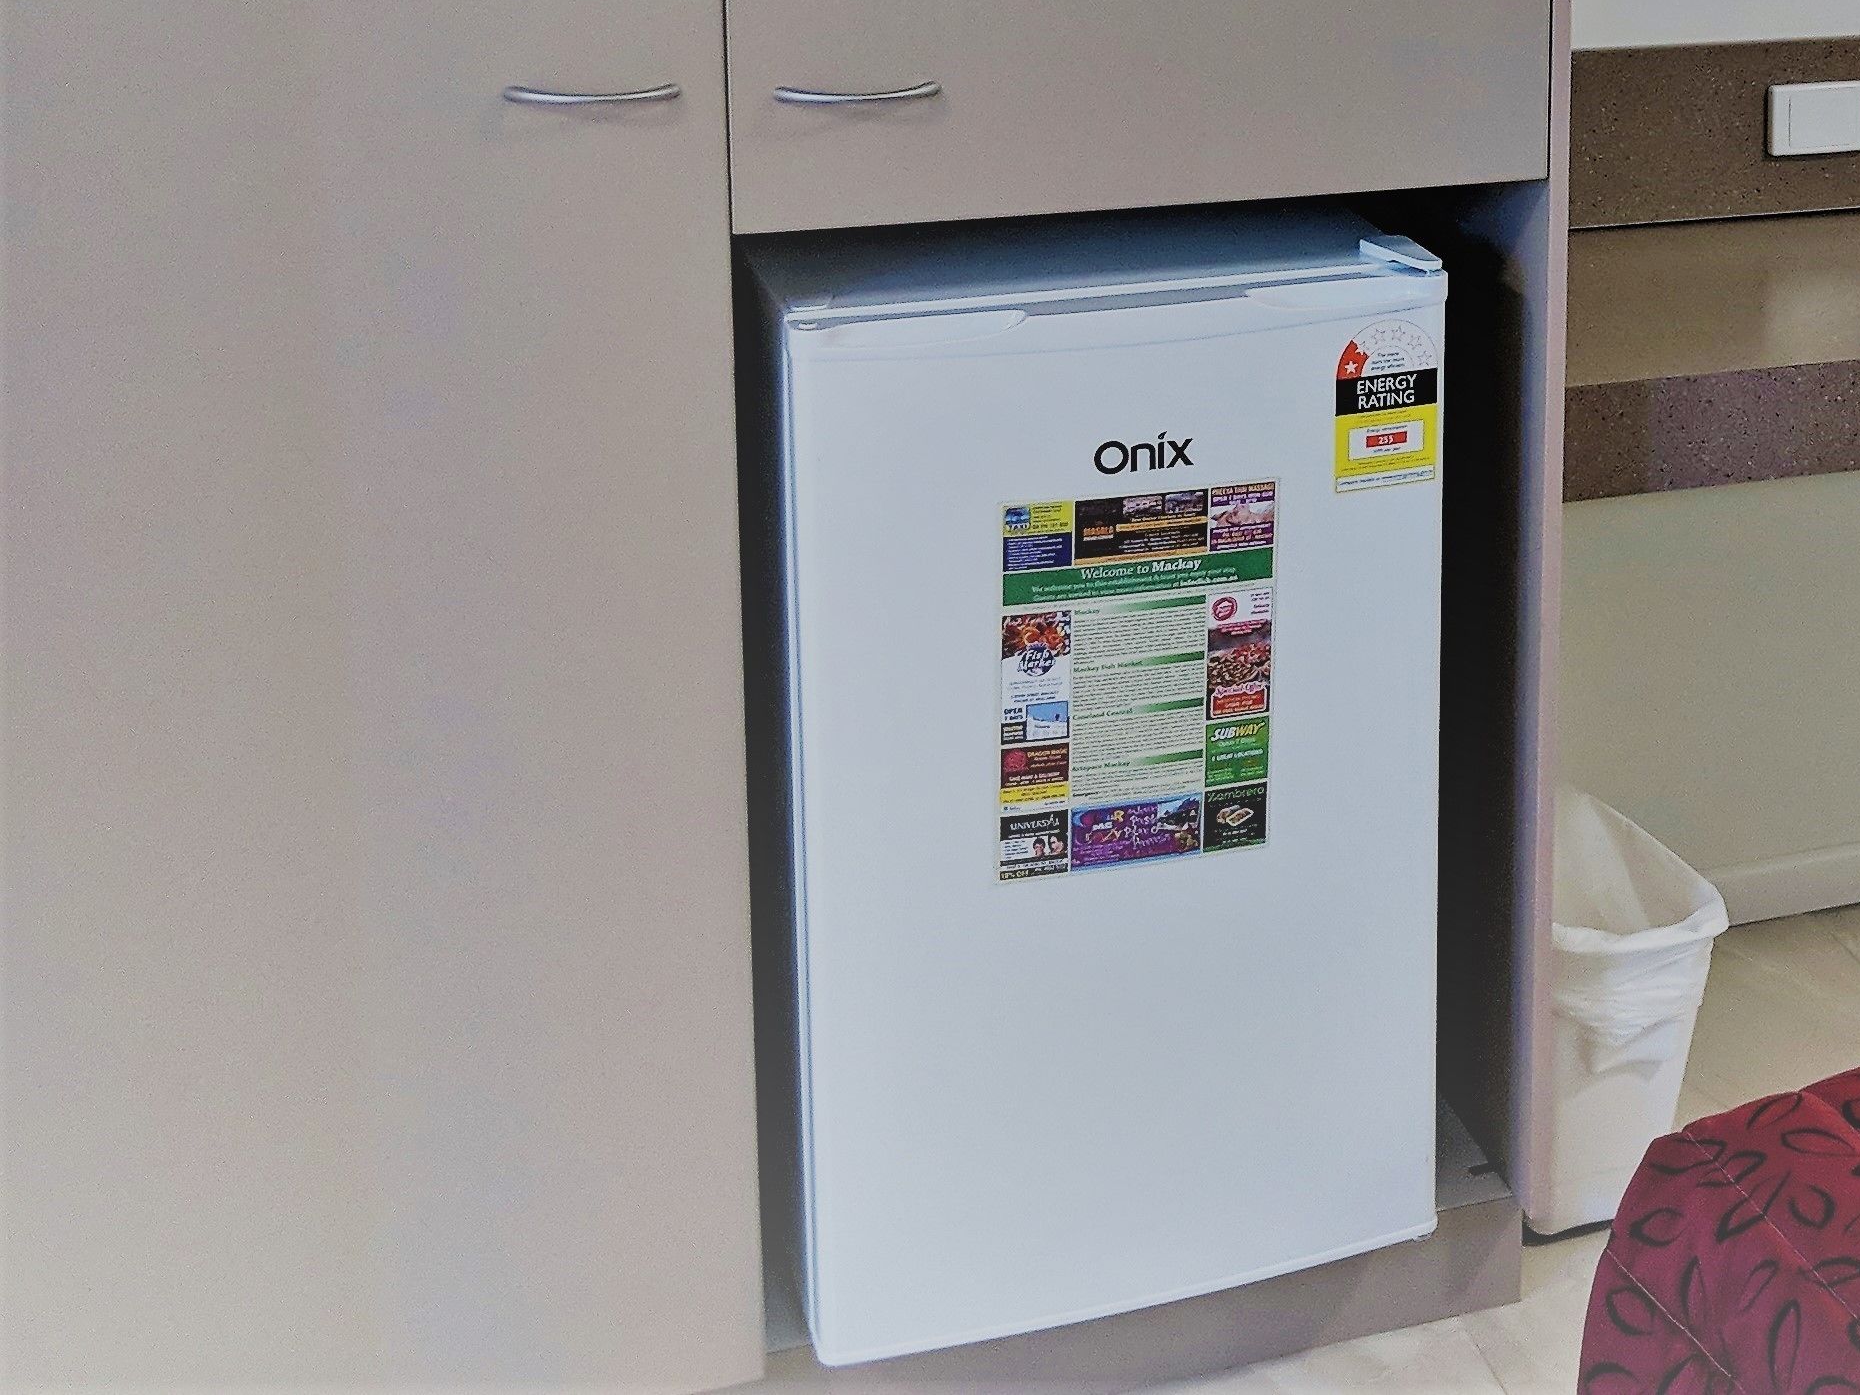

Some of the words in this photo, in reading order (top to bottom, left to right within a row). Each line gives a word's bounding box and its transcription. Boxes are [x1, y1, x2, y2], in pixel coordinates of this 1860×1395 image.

[1356, 374, 1418, 395] ENERGY
[1358, 390, 1416, 409] RATING
[1094, 431, 1194, 475] Onix
[1080, 566, 1134, 580] Welcome
[1137, 564, 1150, 574] to
[1151, 559, 1202, 573] Mackay
[1211, 722, 1265, 742] SUBWAY
